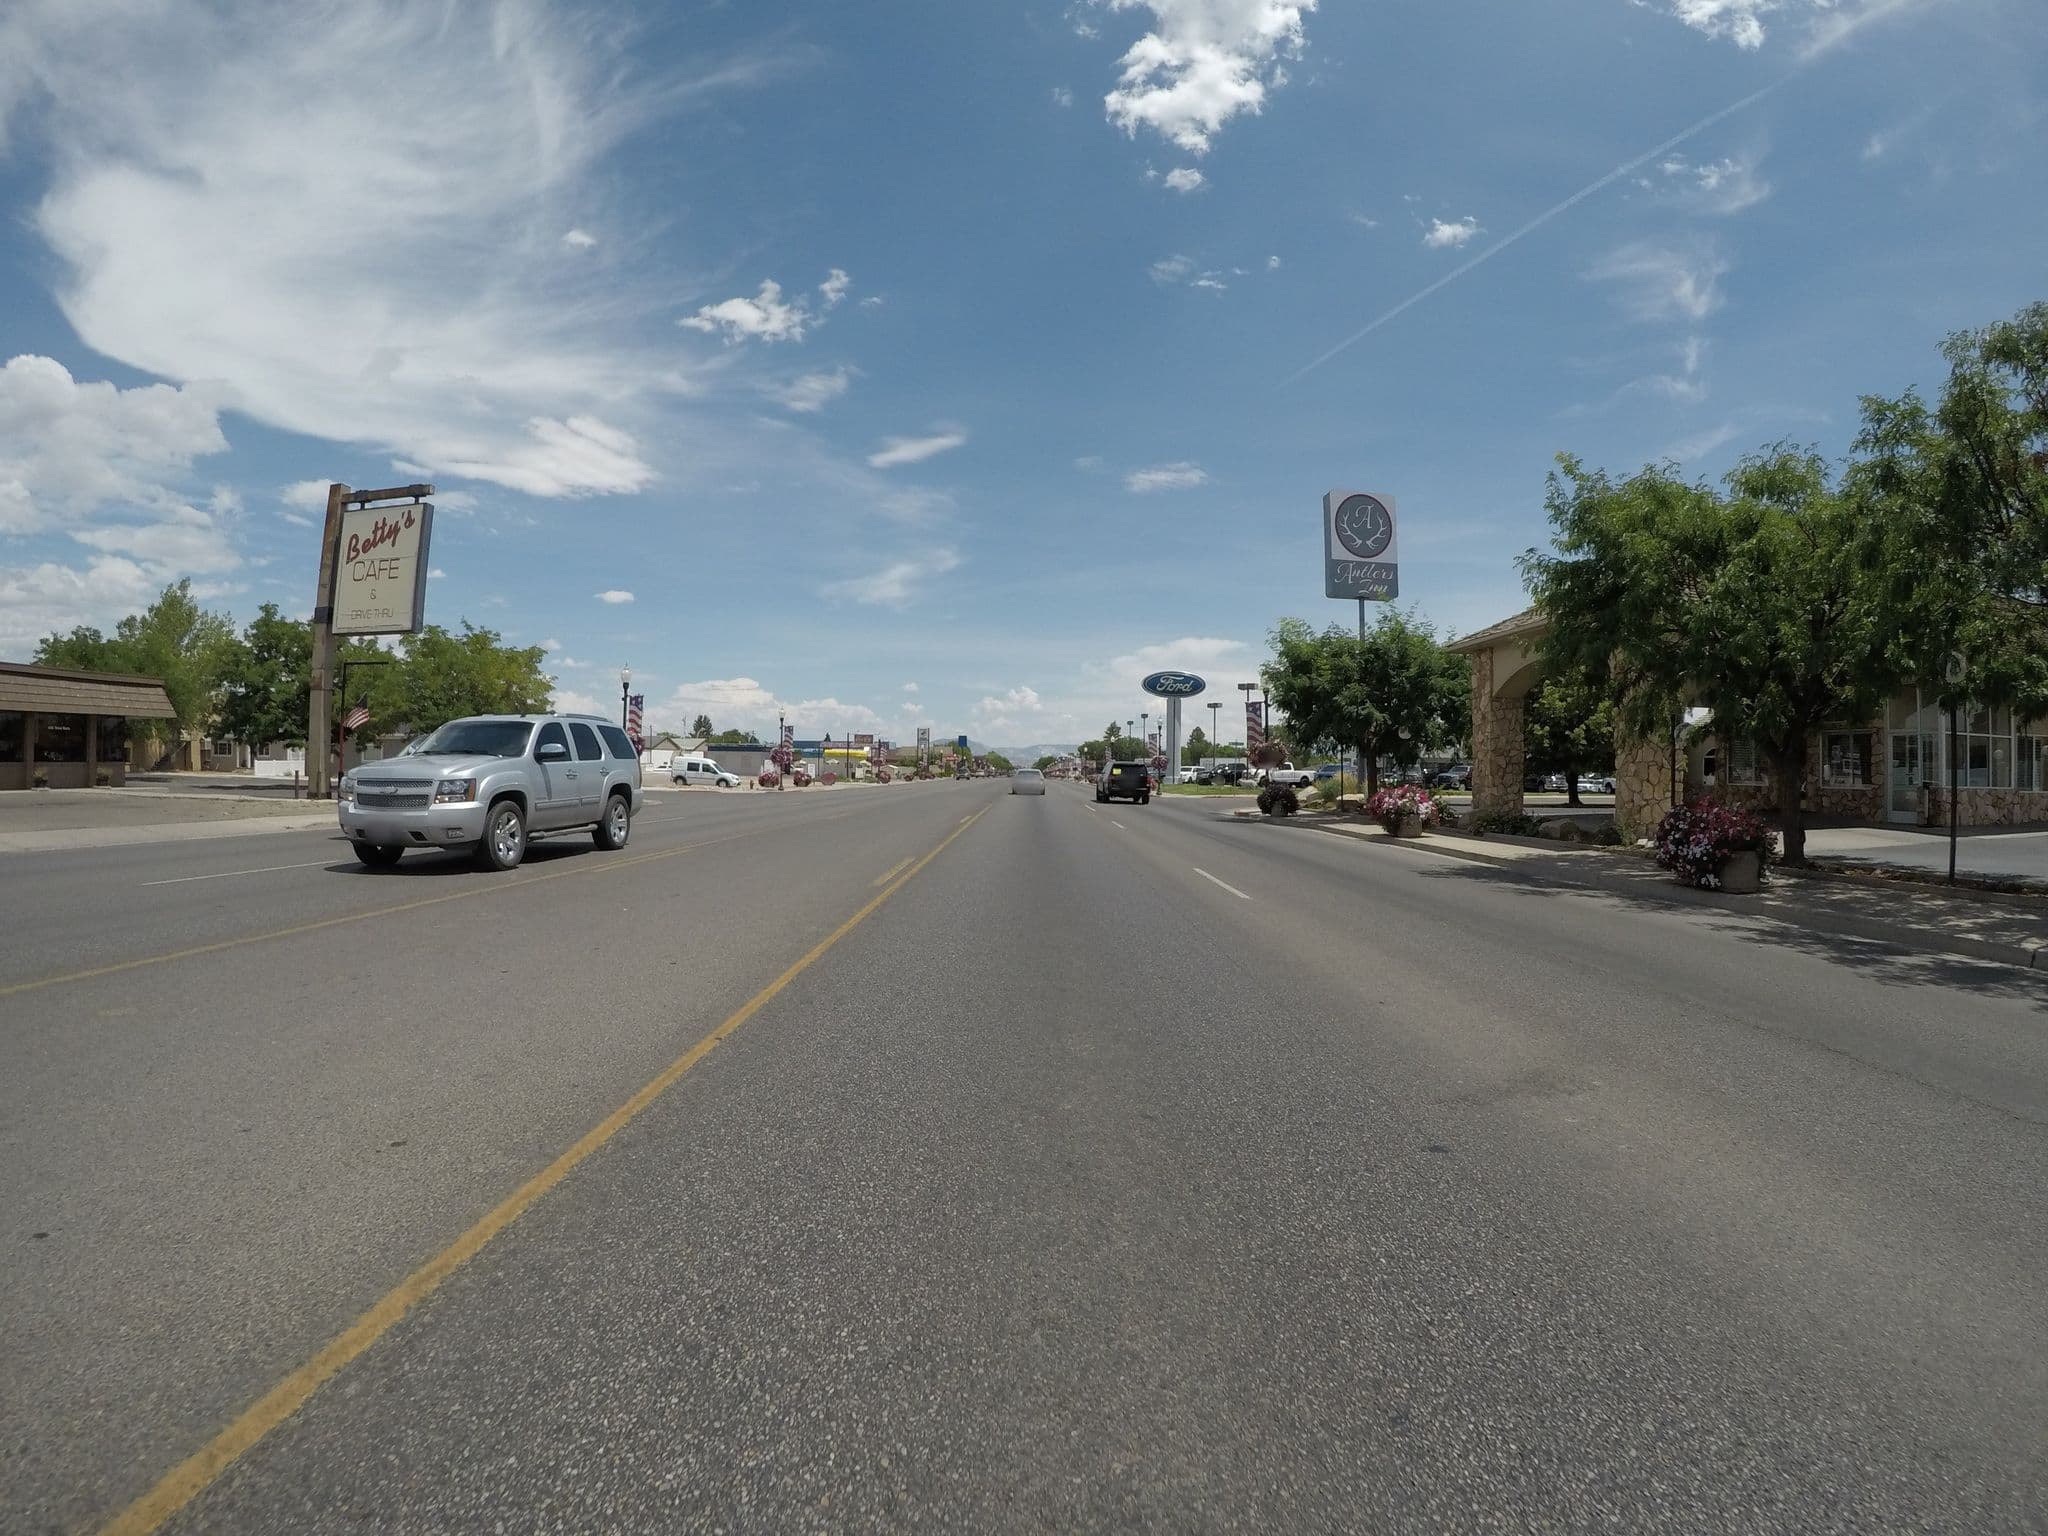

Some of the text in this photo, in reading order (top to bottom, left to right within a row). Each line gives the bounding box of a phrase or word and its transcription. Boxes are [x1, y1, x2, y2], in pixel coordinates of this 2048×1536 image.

[345, 509, 416, 565] Betty's
[352, 558, 401, 582] CAFE
[1334, 561, 1394, 584] Antlers
[1156, 675, 1194, 692] Ford
